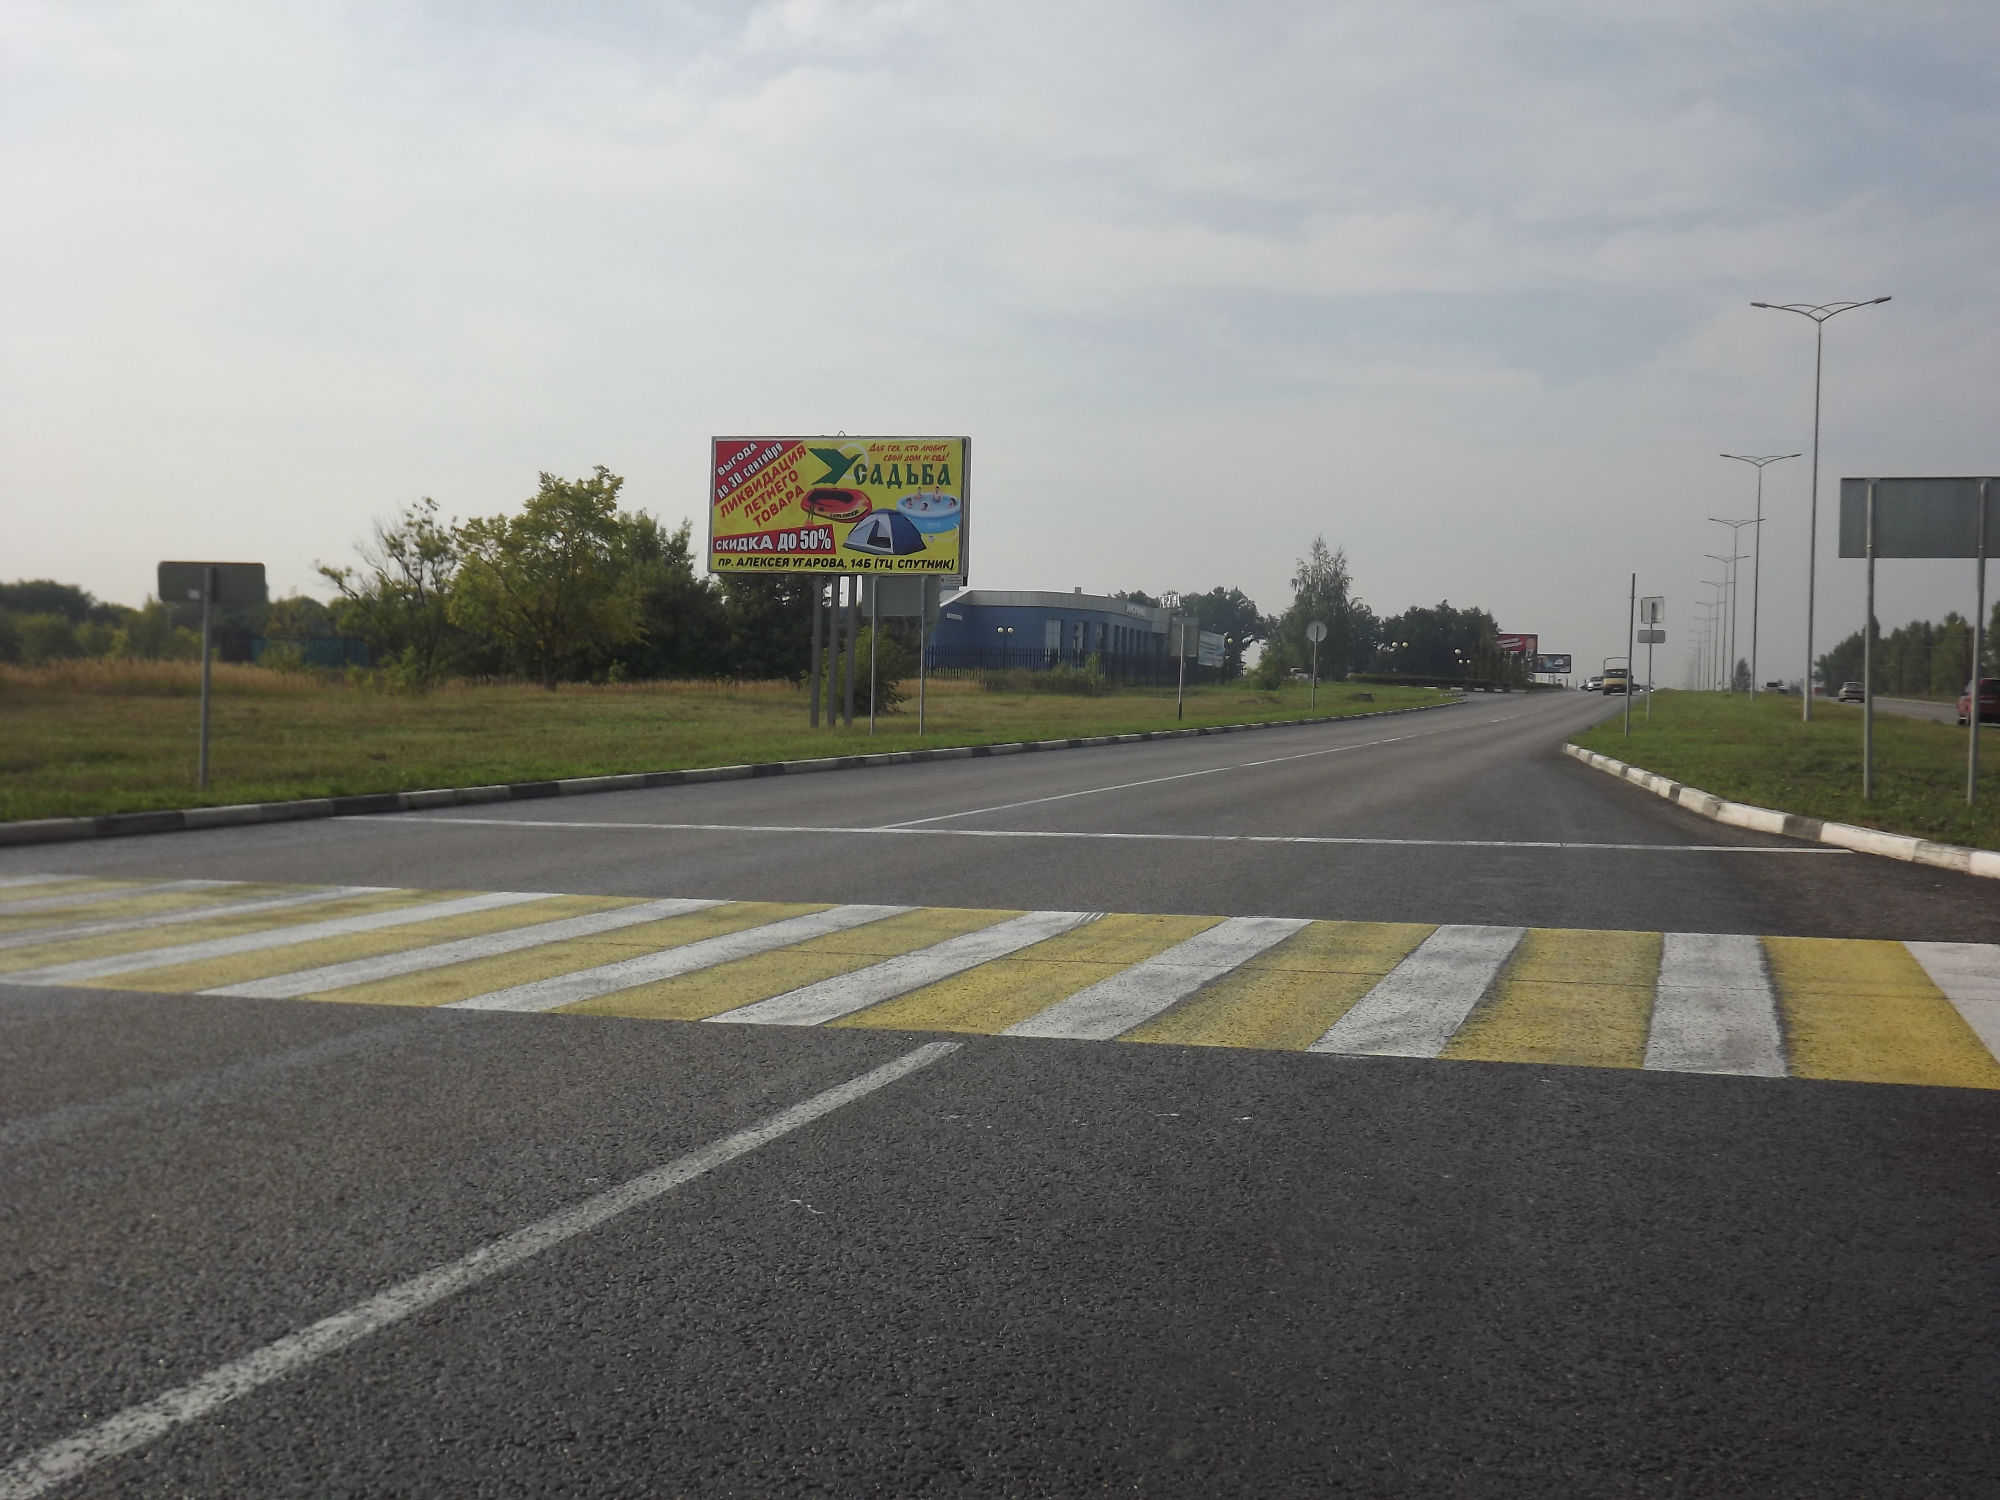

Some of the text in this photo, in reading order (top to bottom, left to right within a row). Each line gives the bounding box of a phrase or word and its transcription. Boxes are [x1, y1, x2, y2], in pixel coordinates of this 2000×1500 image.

[728, 472, 743, 488] 30
[743, 443, 783, 477] сентября
[904, 454, 921, 462] дом
[720, 445, 807, 518] ЛИКВИДАЦИЯ
[744, 469, 799, 518] ЛЕТНЕГО
[753, 485, 805, 527] ТОВАРА
[715, 528, 832, 552] СКИДКА ДО 50%
[718, 557, 955, 570] ПР. АЛЕКСЕЯ УГАРОВА, 14Б (ТЦ СПУТНИК)
